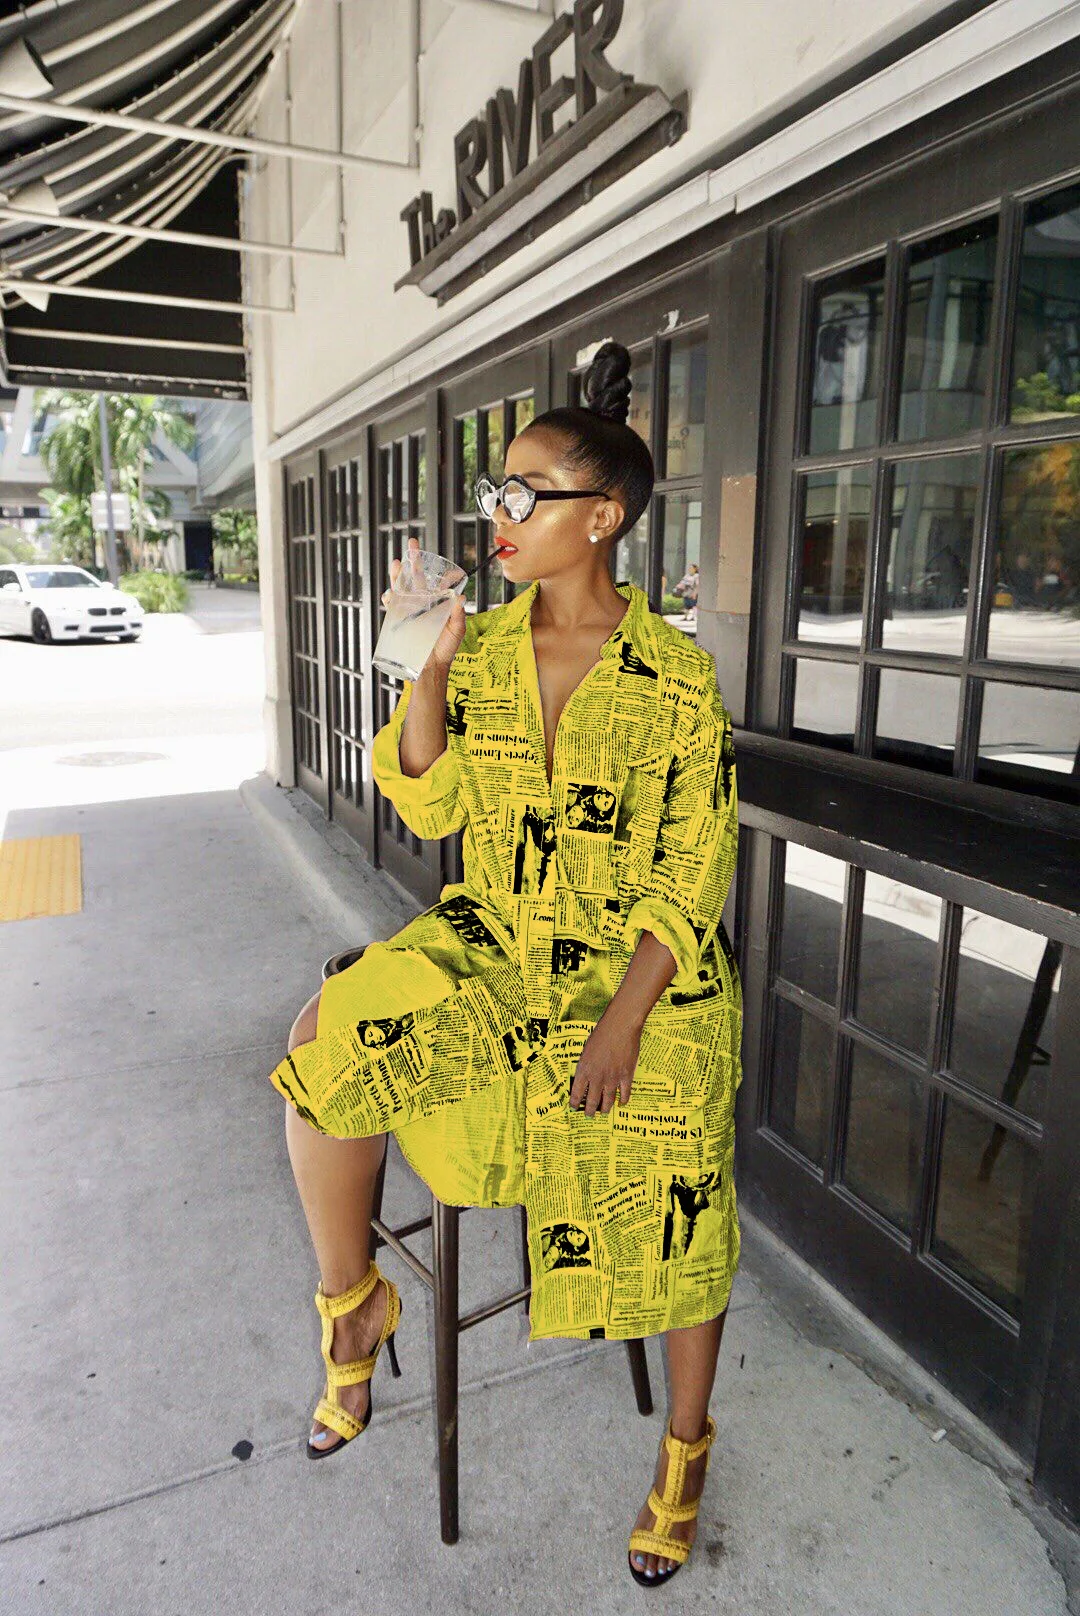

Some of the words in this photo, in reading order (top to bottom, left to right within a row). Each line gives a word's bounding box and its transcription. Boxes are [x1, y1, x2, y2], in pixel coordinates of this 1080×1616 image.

[454, 0, 634, 223] RIVER
[400, 190, 456, 266] The
[618, 1111, 629, 1121] in
[632, 1112, 687, 1126] Provisions
[613, 1124, 647, 1137] Enviro
[650, 1128, 688, 1140] Rejects
[593, 1190, 619, 1210] Pressure
[618, 1186, 628, 1195] for
